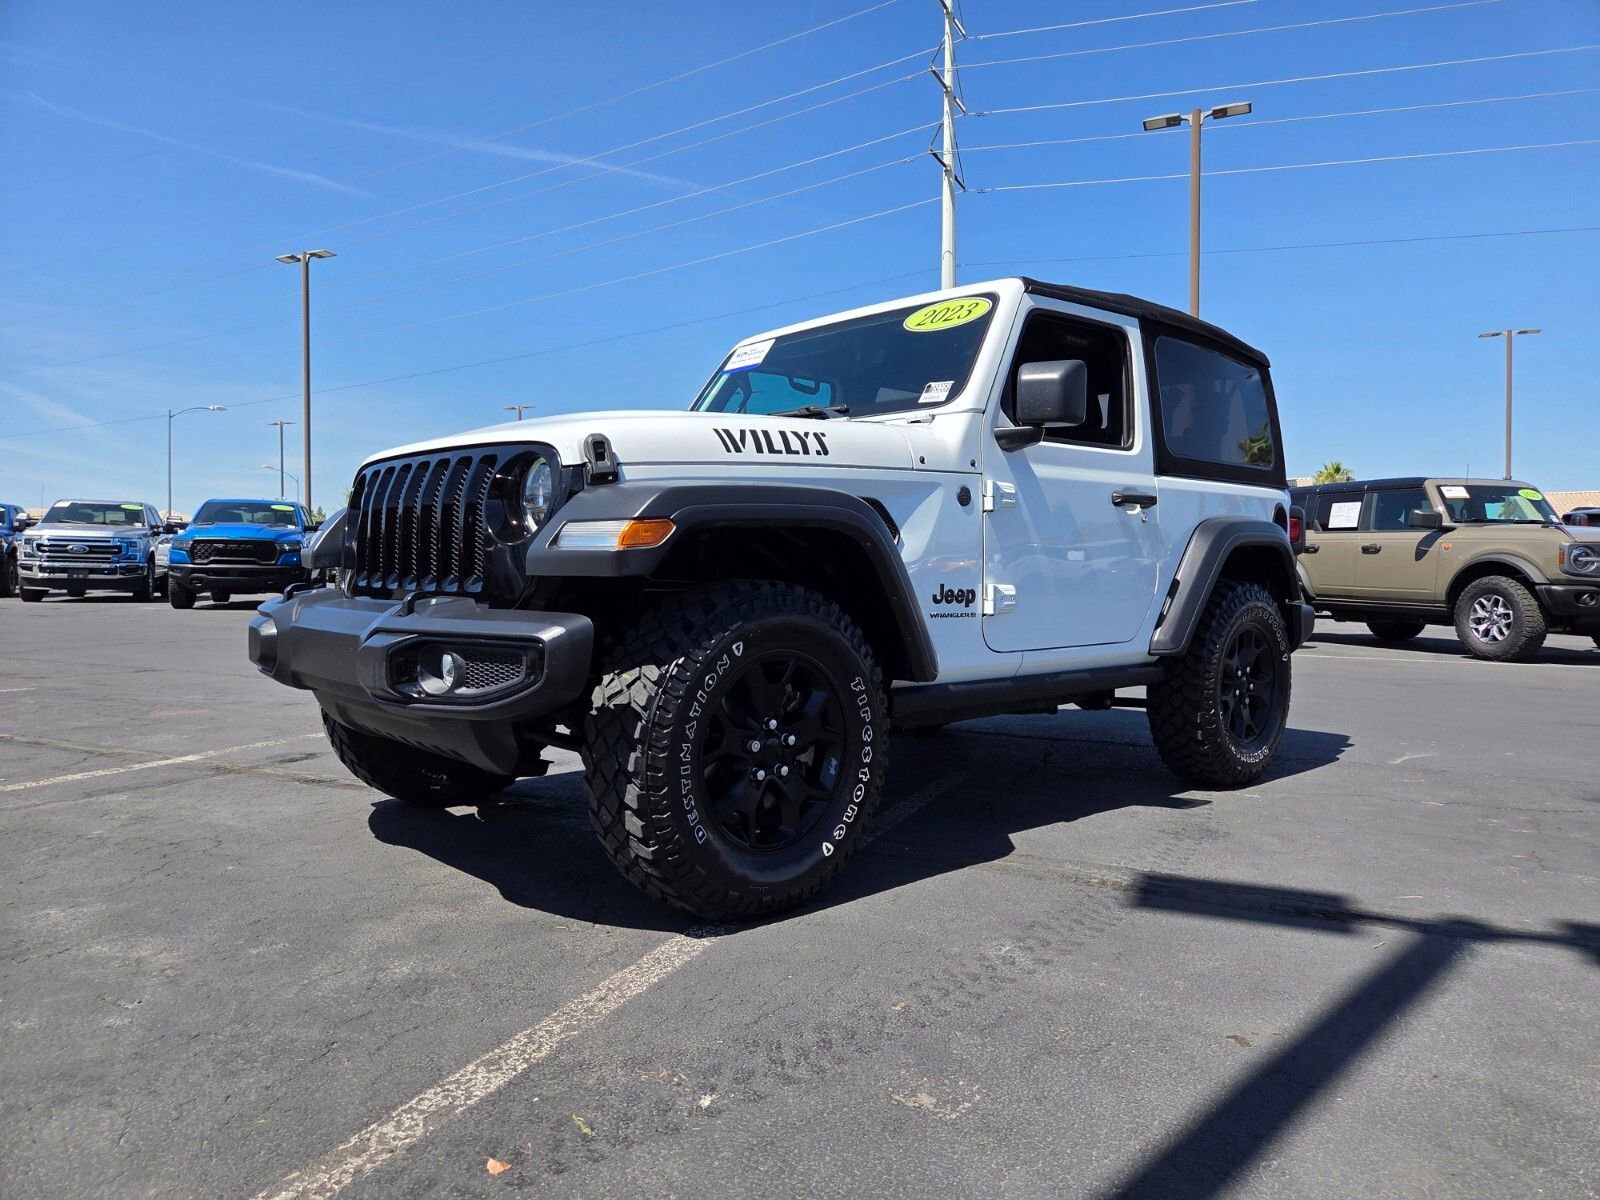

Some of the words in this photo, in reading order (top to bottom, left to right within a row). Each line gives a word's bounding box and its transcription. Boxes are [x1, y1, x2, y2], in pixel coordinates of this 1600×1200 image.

[915, 302, 980, 327] 2023
[712, 428, 829, 456] WILLYS
[932, 584, 976, 608] Jeep
[680, 653, 730, 845] DESTINATION
